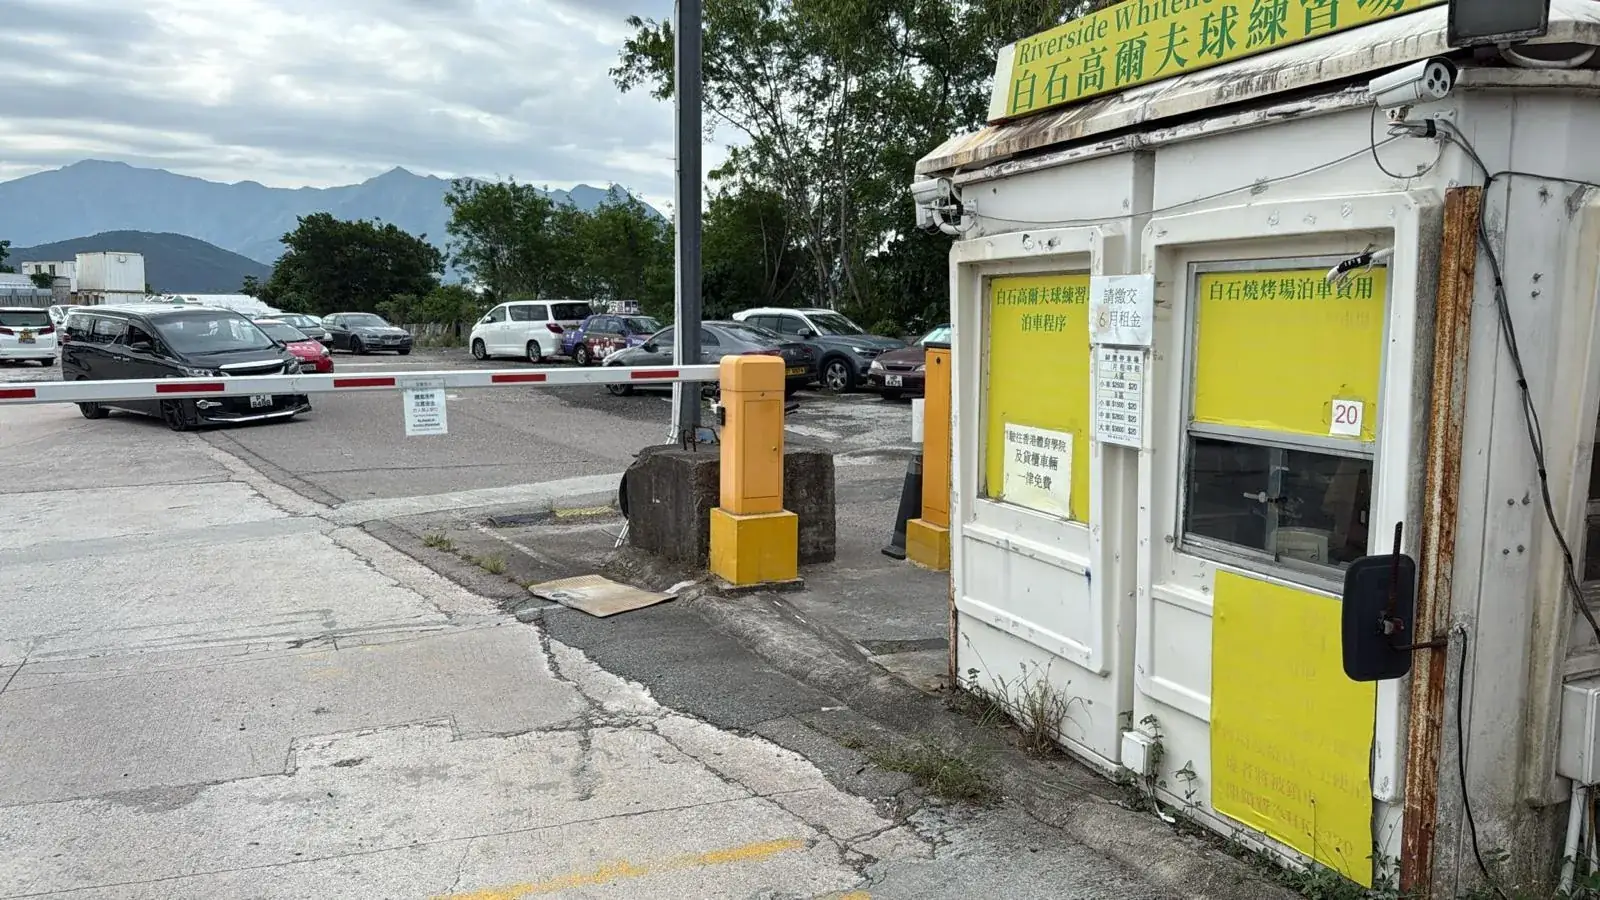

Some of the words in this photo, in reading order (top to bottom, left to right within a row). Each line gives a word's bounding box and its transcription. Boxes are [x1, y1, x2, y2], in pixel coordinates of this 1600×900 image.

[1018, 16, 1109, 66] Riverside
[1114, 0, 1214, 33] White
[1012, 0, 1405, 114] 白石高爾夫球練習
[996, 286, 1090, 306] 白石高爾夫球練習
[1103, 288, 1137, 305] 請繳交
[1210, 276, 1373, 300] 白石燒烤場泊車費用
[1021, 313, 1066, 332] 泊車程序
[1099, 310, 1141, 328] 6月租金
[1335, 404, 1358, 425] 20
[1017, 471, 1052, 491] 一律免費
